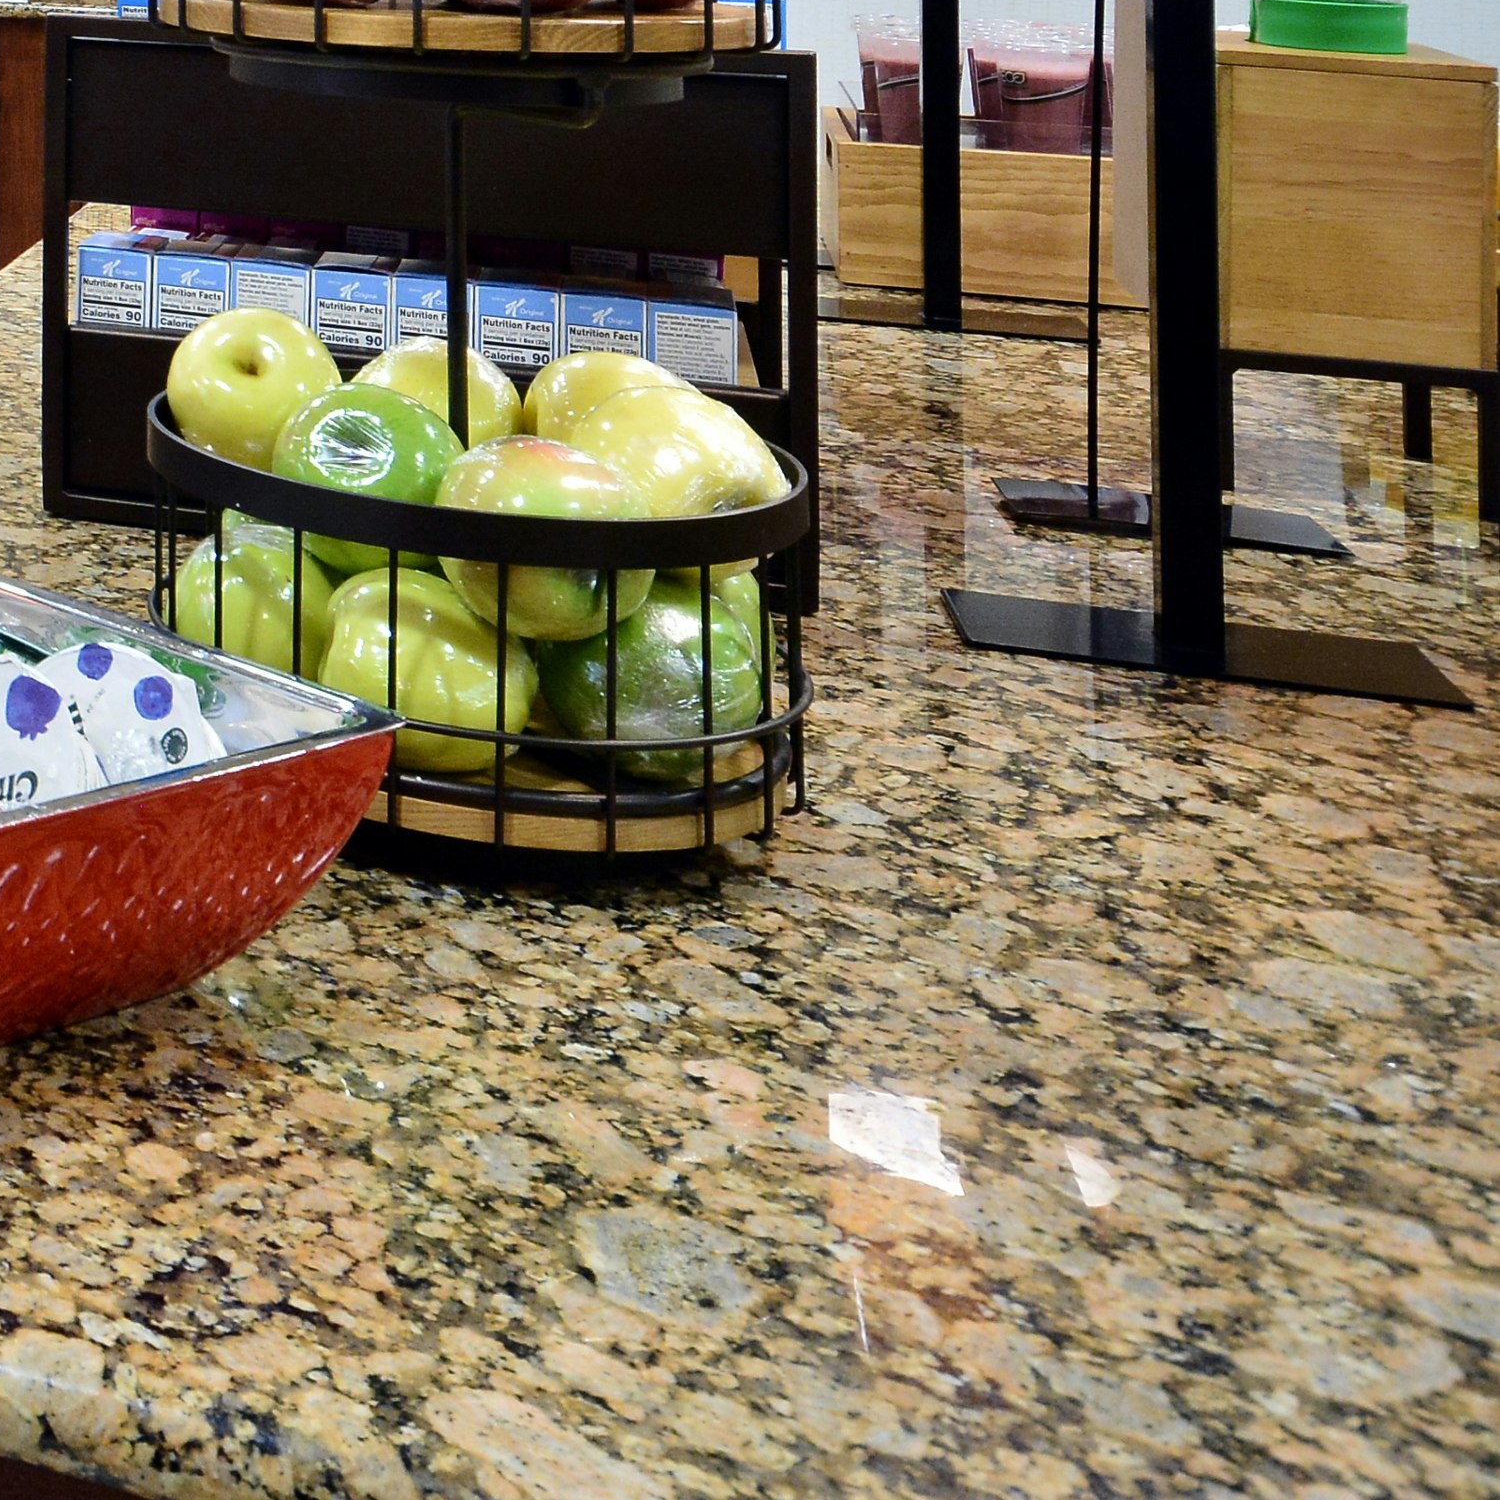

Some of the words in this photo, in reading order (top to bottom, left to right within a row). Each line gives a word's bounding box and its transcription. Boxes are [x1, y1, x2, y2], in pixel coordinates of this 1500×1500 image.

[83, 278, 118, 288] Nutrition
[120, 282, 142, 291] Facts
[161, 287, 196, 298] Nutrition
[199, 291, 221, 300] Facts
[319, 300, 356, 311] Nutrition
[359, 305, 383, 315] Facts
[400, 309, 438, 320] Nutrition
[82, 308, 120, 320] Calories
[125, 310, 142, 322] 90
[483, 318, 522, 329] Nutrition
[526, 322, 550, 332] Facts
[319, 332, 359, 344] Calories
[365, 335, 383, 346] 90
[569, 327, 610, 338] Nutrition
[613, 331, 638, 341] Facts
[483, 350, 526, 362] Calories
[532, 353, 550, 365] 90
